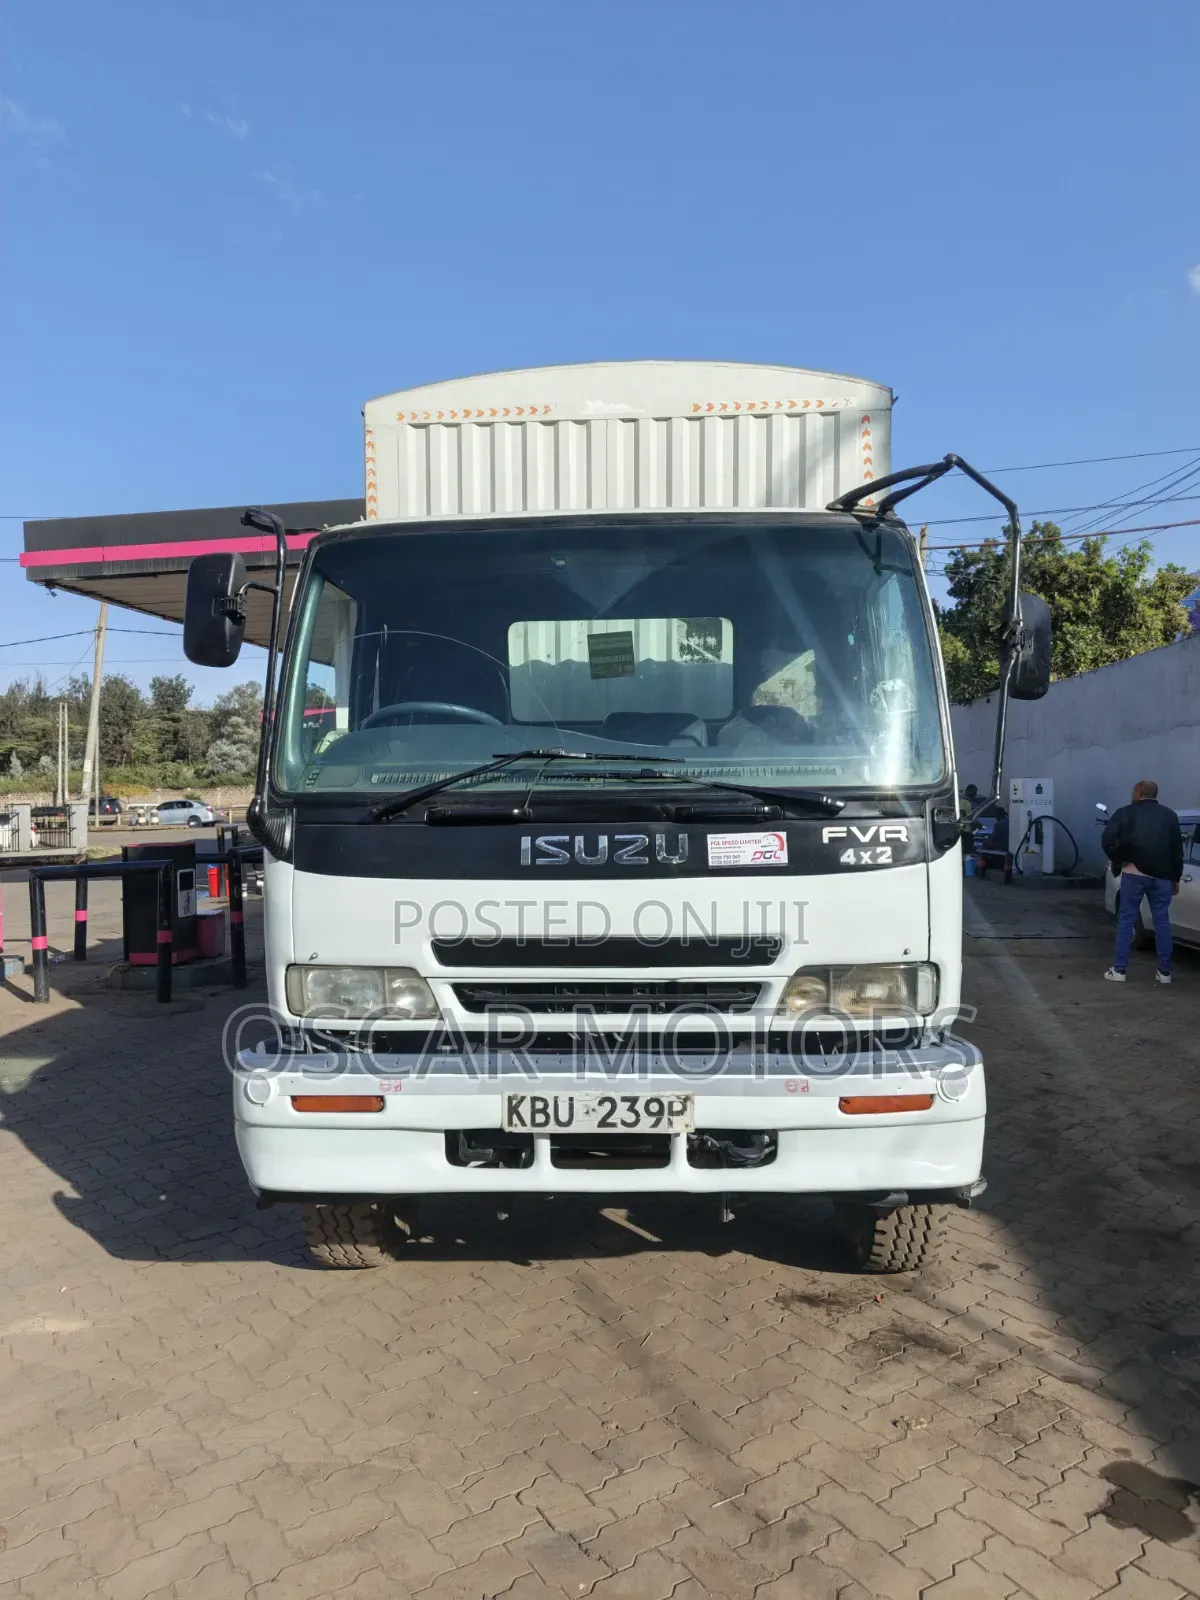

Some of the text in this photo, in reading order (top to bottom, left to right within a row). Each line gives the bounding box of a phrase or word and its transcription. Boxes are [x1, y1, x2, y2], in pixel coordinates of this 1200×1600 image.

[520, 833, 689, 866] ISUZU
[822, 826, 909, 843] FVR
[507, 1096, 688, 1129] KBU 239P
